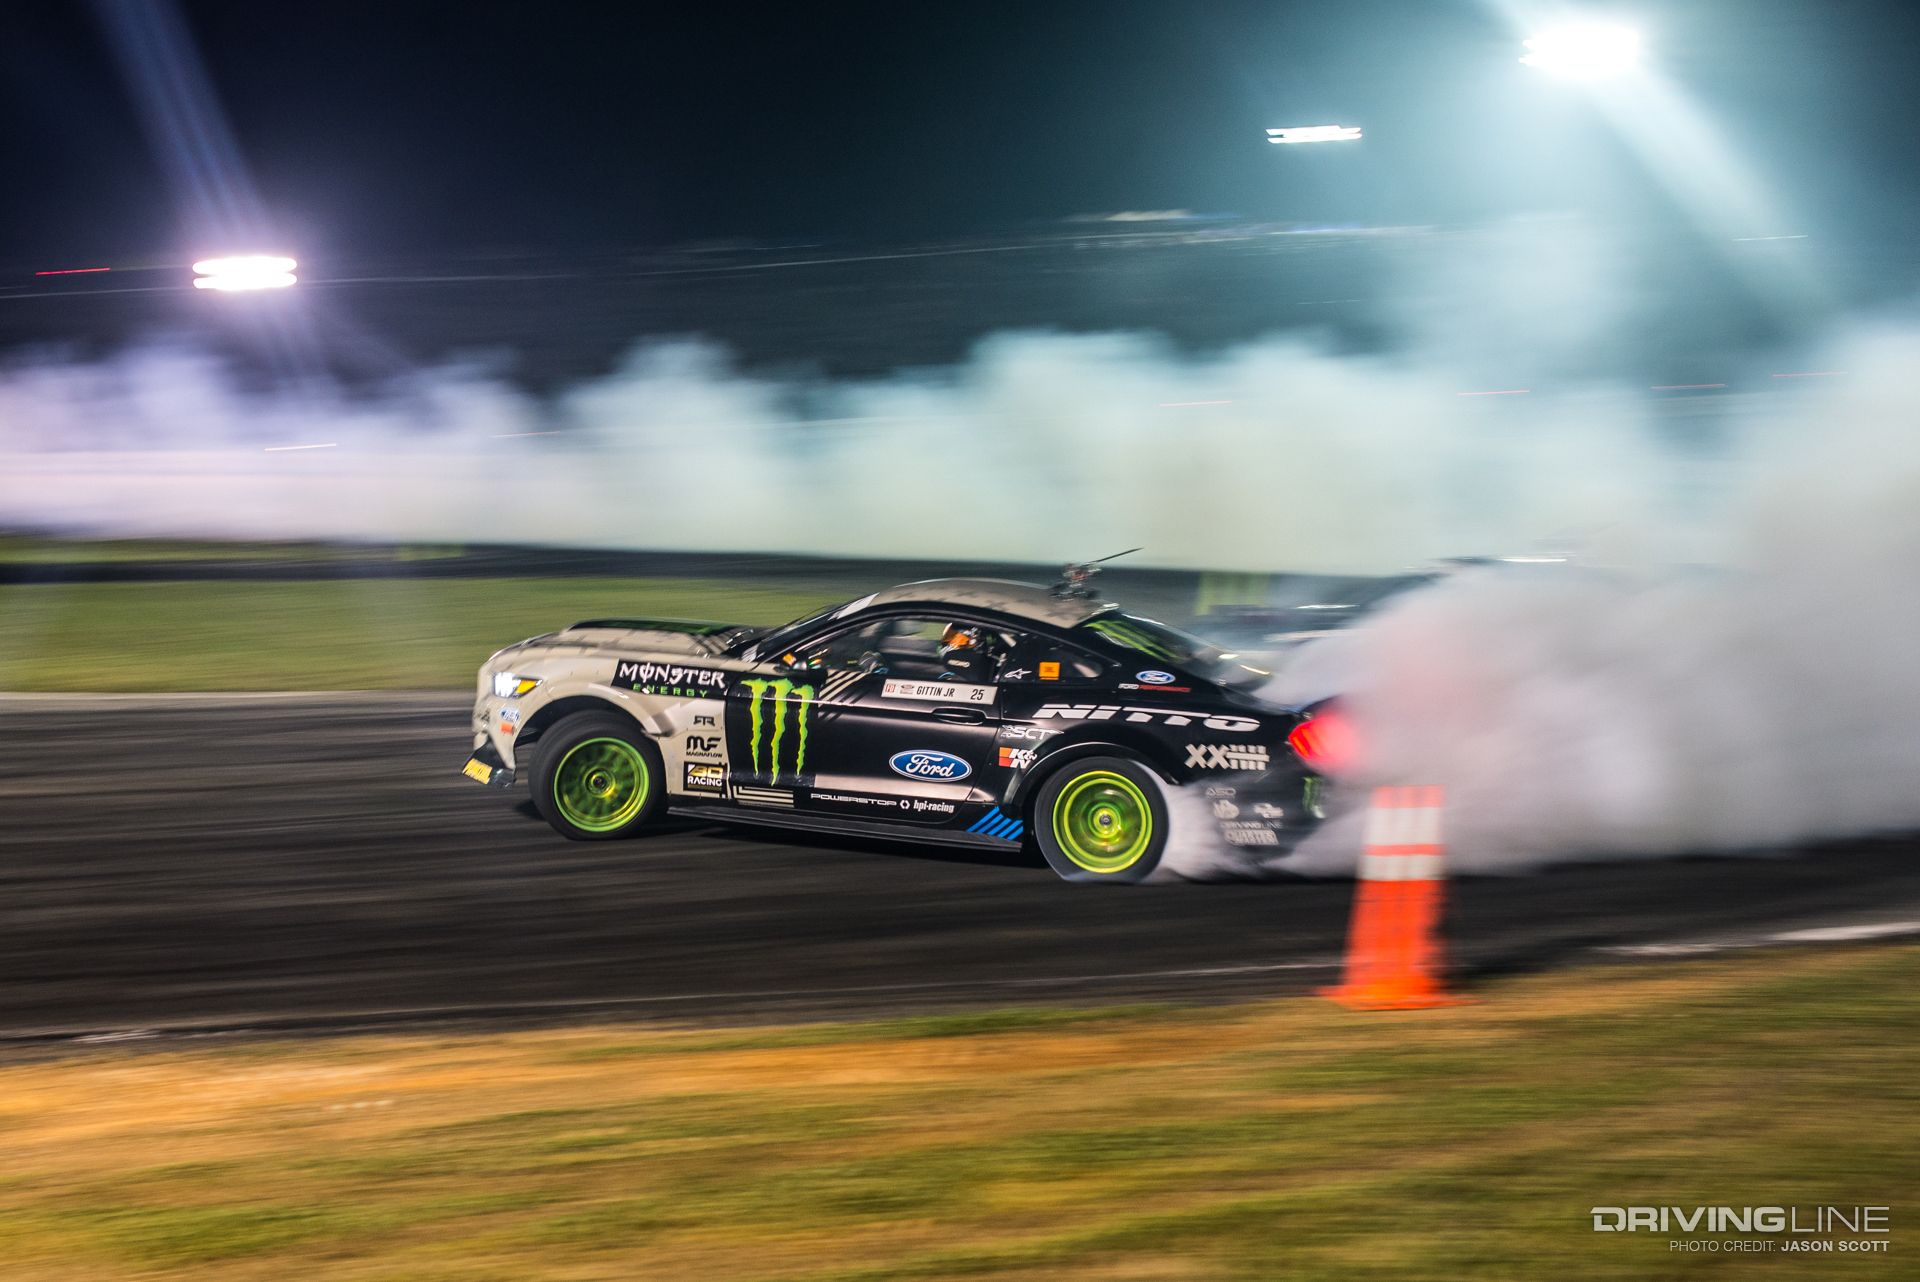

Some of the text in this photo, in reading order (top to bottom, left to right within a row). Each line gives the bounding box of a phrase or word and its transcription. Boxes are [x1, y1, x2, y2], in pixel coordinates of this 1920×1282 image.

[619, 662, 725, 689] MONSTER
[633, 683, 708, 698] ENERGY
[916, 686, 943, 697] GITTIN
[943, 688, 956, 698] JR
[970, 689, 985, 701] 25
[1031, 704, 1260, 732] NITTO
[905, 754, 956, 777] Ford
[687, 775, 723, 787] RACING
[810, 793, 897, 806] POWERSTOP
